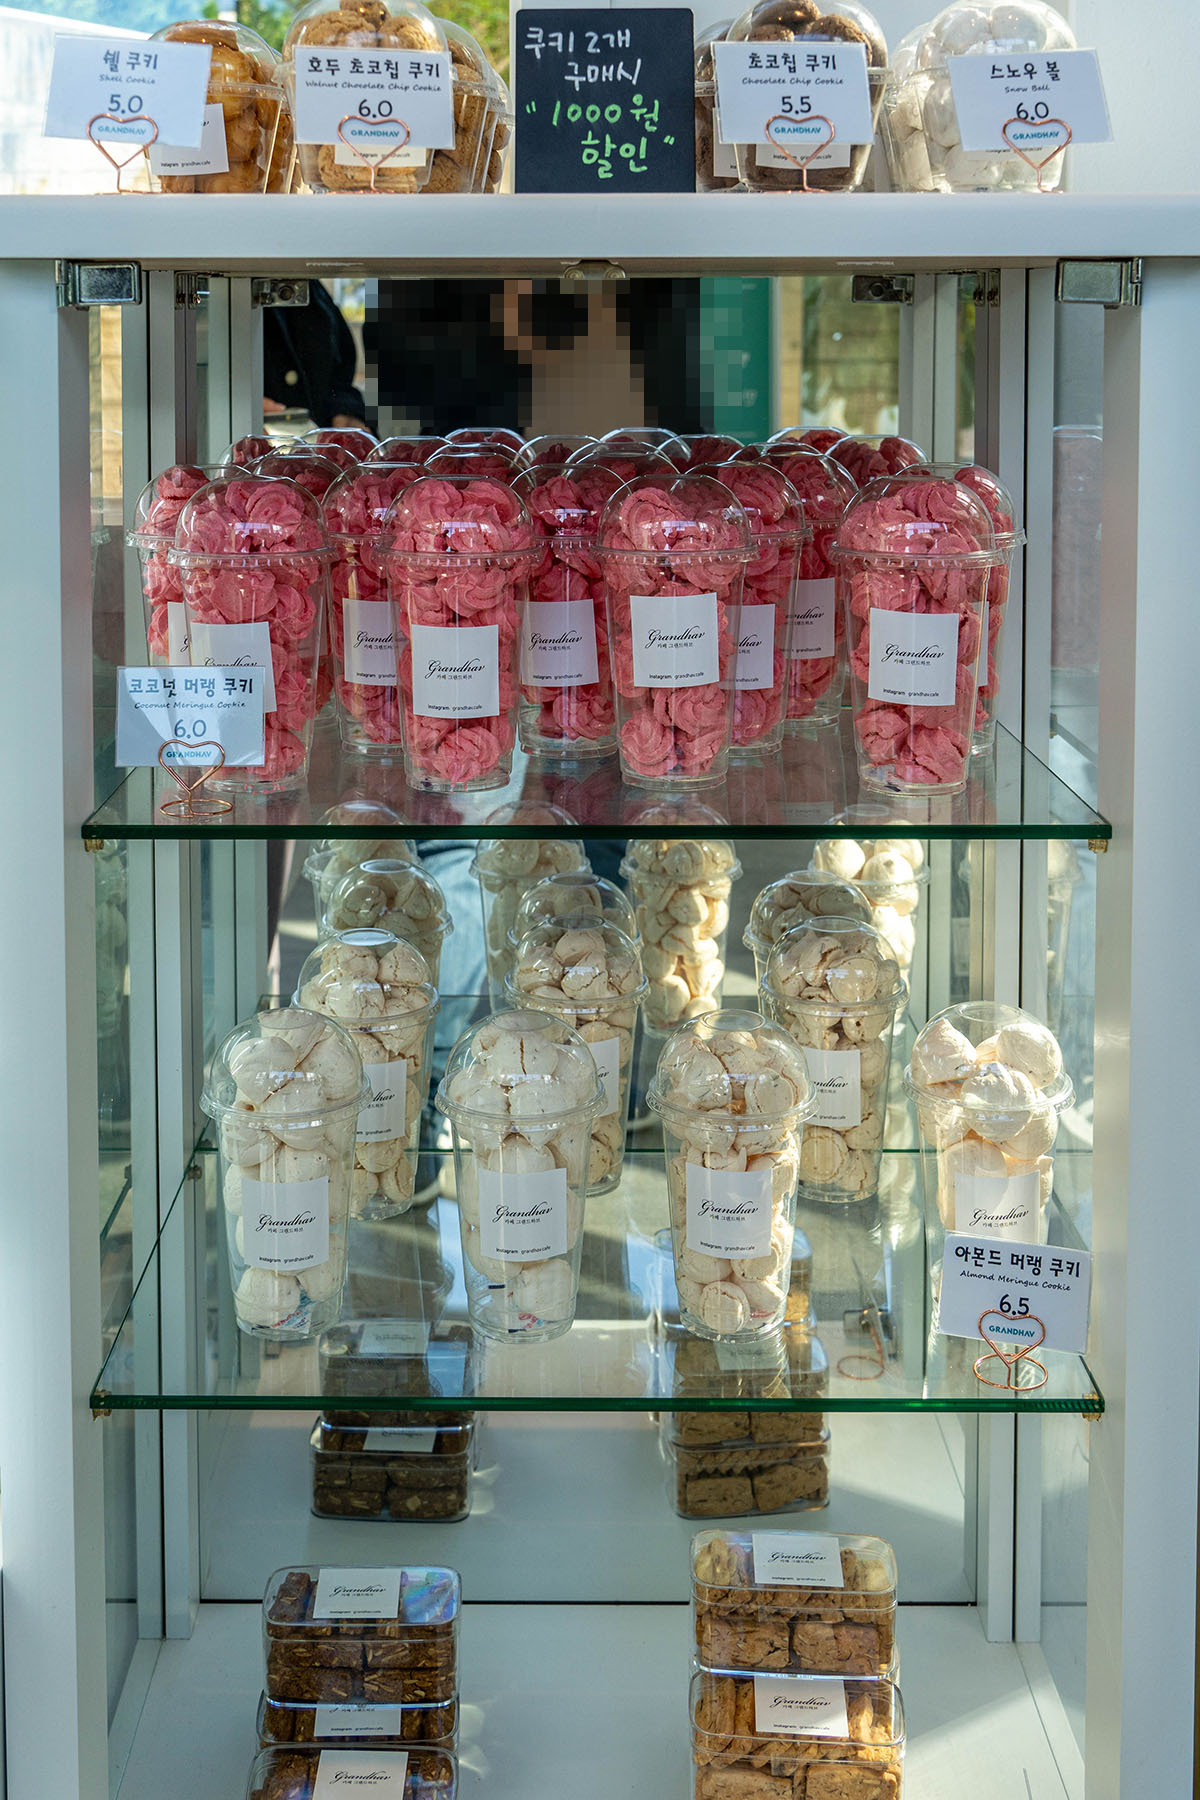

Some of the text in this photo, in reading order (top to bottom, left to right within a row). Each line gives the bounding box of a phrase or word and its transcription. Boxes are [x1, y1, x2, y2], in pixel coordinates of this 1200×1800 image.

[525, 27, 631, 59] 쿠키 2개
[103, 49, 158, 73] 쉘 쿠키
[308, 56, 440, 79] 호두 초코칩 쿠키
[748, 52, 837, 74] 초코칩 쿠키
[990, 61, 1061, 81] 스노우 볼
[99, 74, 156, 85] Shell Cookie
[564, 58, 642, 91] 구매시
[742, 76, 843, 86] Chocolate Chip Cookie
[305, 80, 442, 92] Walnut Chocolate Chip Cookie
[1004, 84, 1051, 94] Snow Ball
[108, 93, 143, 114] 5.0
[358, 99, 393, 118] 6.0
[781, 96, 812, 115] 5.5
[1015, 101, 1050, 121] 6.0
[98, 126, 147, 135] GRANDHAV
[350, 129, 400, 138] GRANDHAV
[1012, 131, 1060, 141] GRANDHAV
[528, 629, 583, 651] Grandhav
[644, 625, 706, 649] Grandhav
[881, 643, 944, 662] Grandhav
[424, 657, 486, 679] Grandhav
[128, 678, 253, 698] 코코넛 머랭 쿠키
[173, 701, 214, 711] Meringue
[216, 701, 246, 709] Cookie
[174, 719, 207, 739] 6.0
[166, 750, 212, 759] GRANDHAV
[491, 1201, 553, 1223] Grandhav
[697, 1198, 759, 1217] Grandhav
[969, 1204, 1030, 1227] Grandhav
[255, 1210, 316, 1232] Grandhav
[955, 1245, 1080, 1278] 아몬드 머랭 쿠키
[960, 1269, 1071, 1291] Almond Meringue Cookie
[999, 1294, 1030, 1316] 6.5
[988, 1325, 1036, 1338] GRANDHAV
[769, 1695, 831, 1708] Grandhav
[329, 1770, 392, 1785] Grandhav
